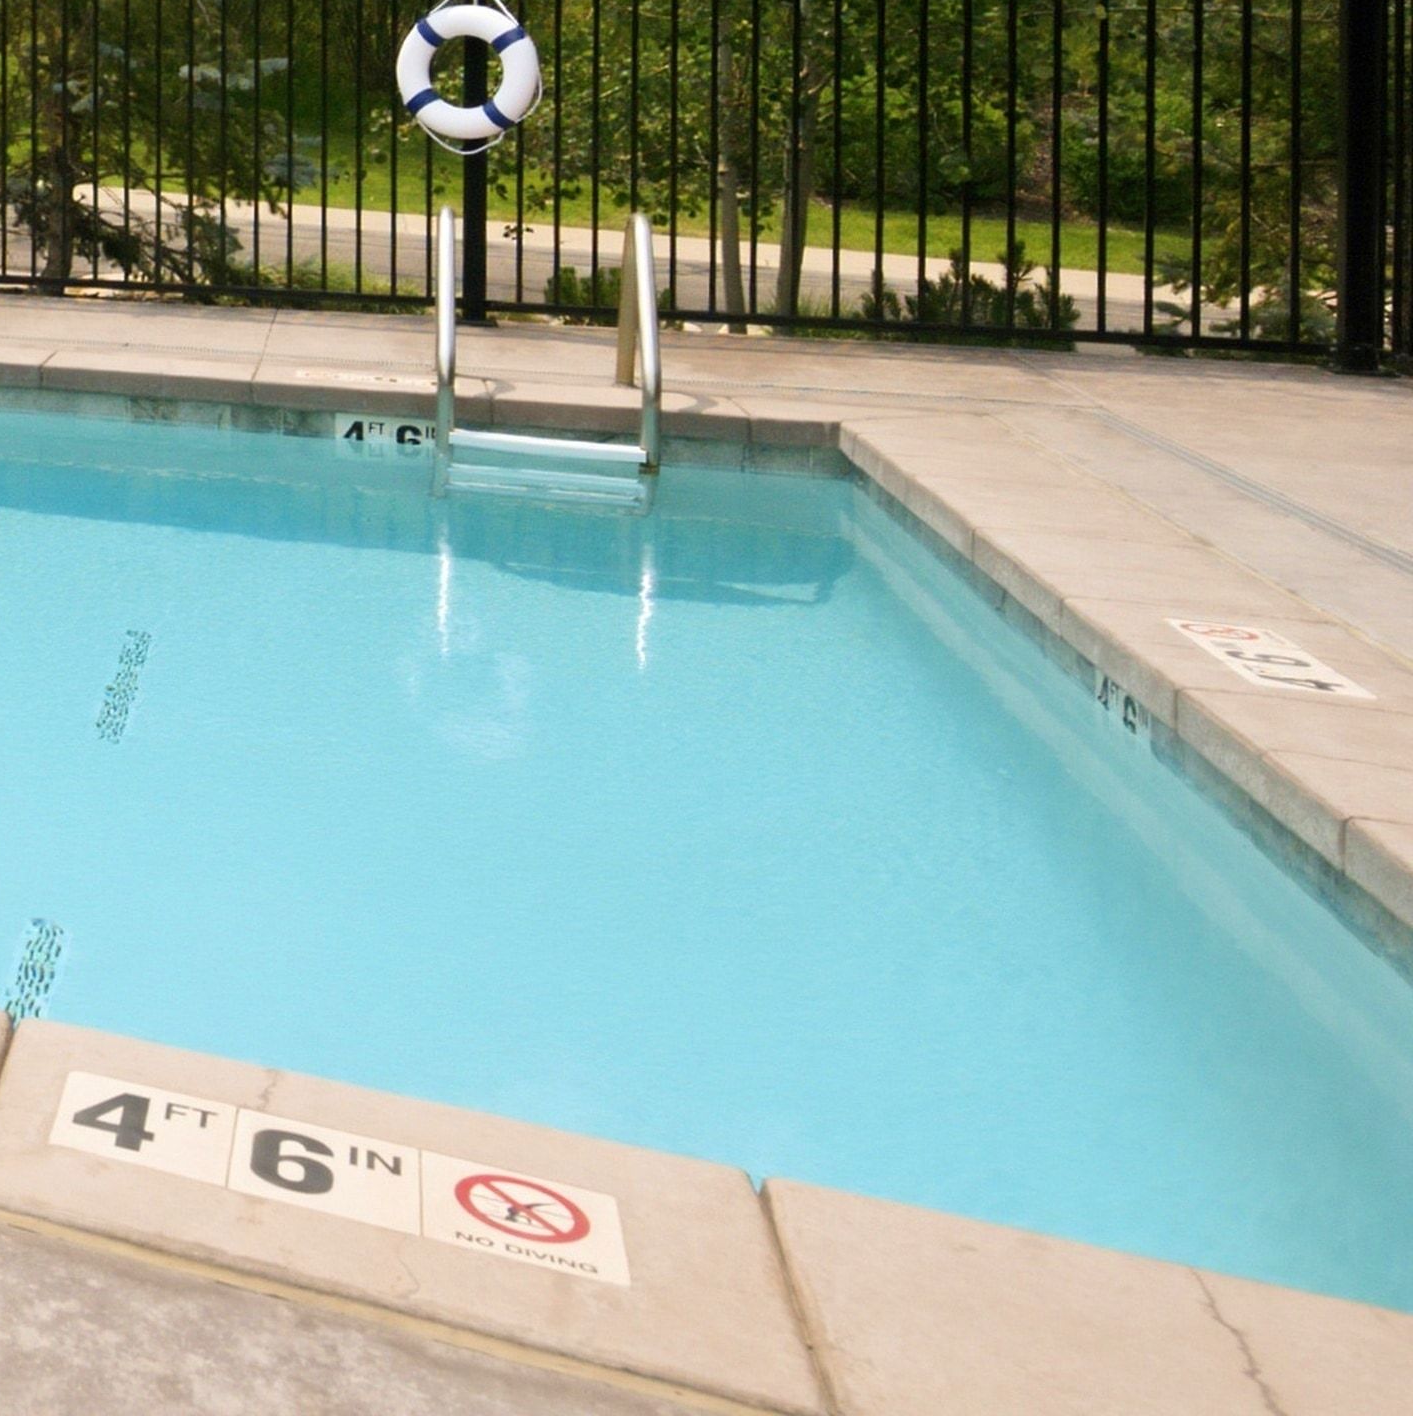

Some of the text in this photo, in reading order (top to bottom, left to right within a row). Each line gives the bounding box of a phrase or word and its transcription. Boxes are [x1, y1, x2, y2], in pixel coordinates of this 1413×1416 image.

[72, 1092, 402, 1195] 4 FT 6 IN
[455, 1230, 599, 1275] NO DIVING
